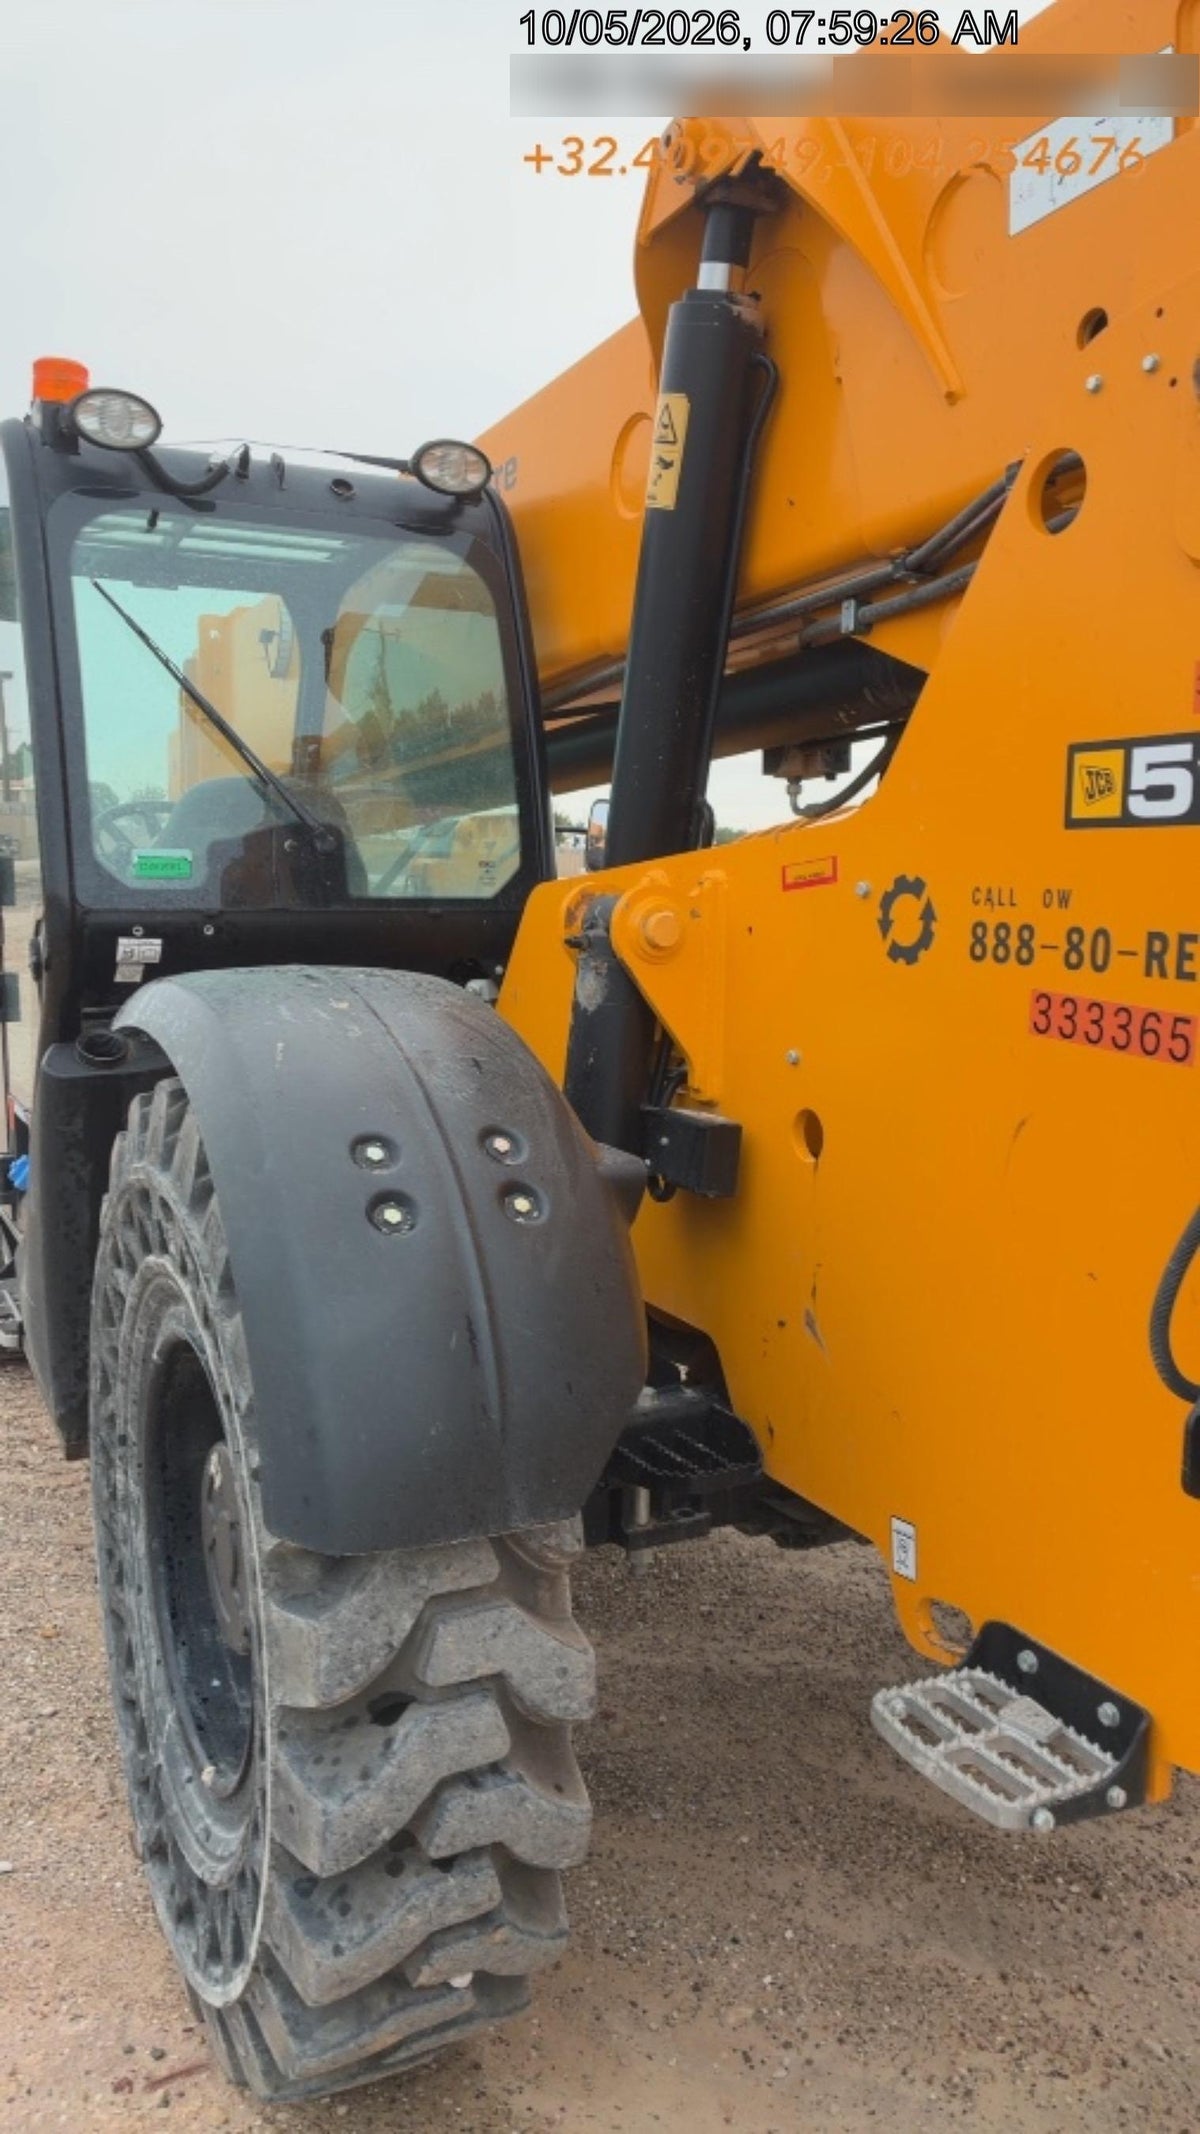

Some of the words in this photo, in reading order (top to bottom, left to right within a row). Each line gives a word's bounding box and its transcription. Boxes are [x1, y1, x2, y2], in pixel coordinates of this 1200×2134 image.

[1084, 767, 1116, 801] JCB
[1128, 743, 1200, 819] 5
[971, 886, 1017, 910] CALL
[1033, 993, 1192, 1063] 333365
